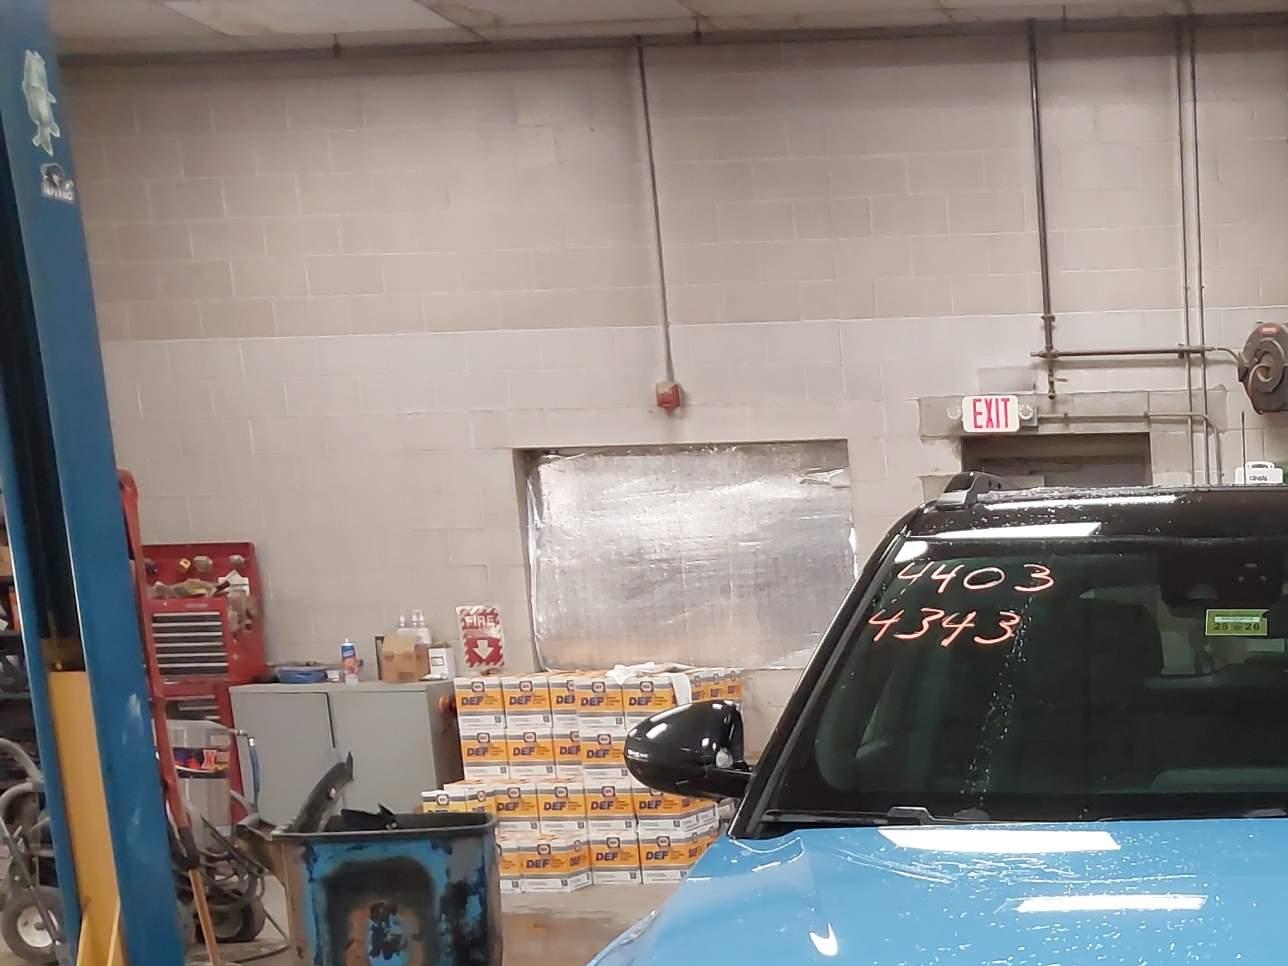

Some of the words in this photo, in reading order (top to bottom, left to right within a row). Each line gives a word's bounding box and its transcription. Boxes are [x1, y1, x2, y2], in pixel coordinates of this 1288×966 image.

[972, 397, 1010, 429] EXIT
[897, 560, 1055, 593] 4403
[463, 614, 496, 628] FIRE
[867, 607, 1021, 647] 4343
[461, 696, 483, 706] DEF
[509, 695, 532, 706] DEF
[580, 697, 604, 706] DEF
[628, 697, 652, 706] DEF
[467, 747, 489, 757] DEF
[513, 746, 535, 756] DEF
[586, 750, 610, 759] DEF
[496, 802, 520, 812] DEF
[543, 801, 567, 811] DEF
[590, 800, 614, 811] DEF
[639, 800, 663, 810] DEF
[595, 851, 619, 861] DEF
[645, 851, 669, 860] DEF
[526, 859, 550, 868] DEF
